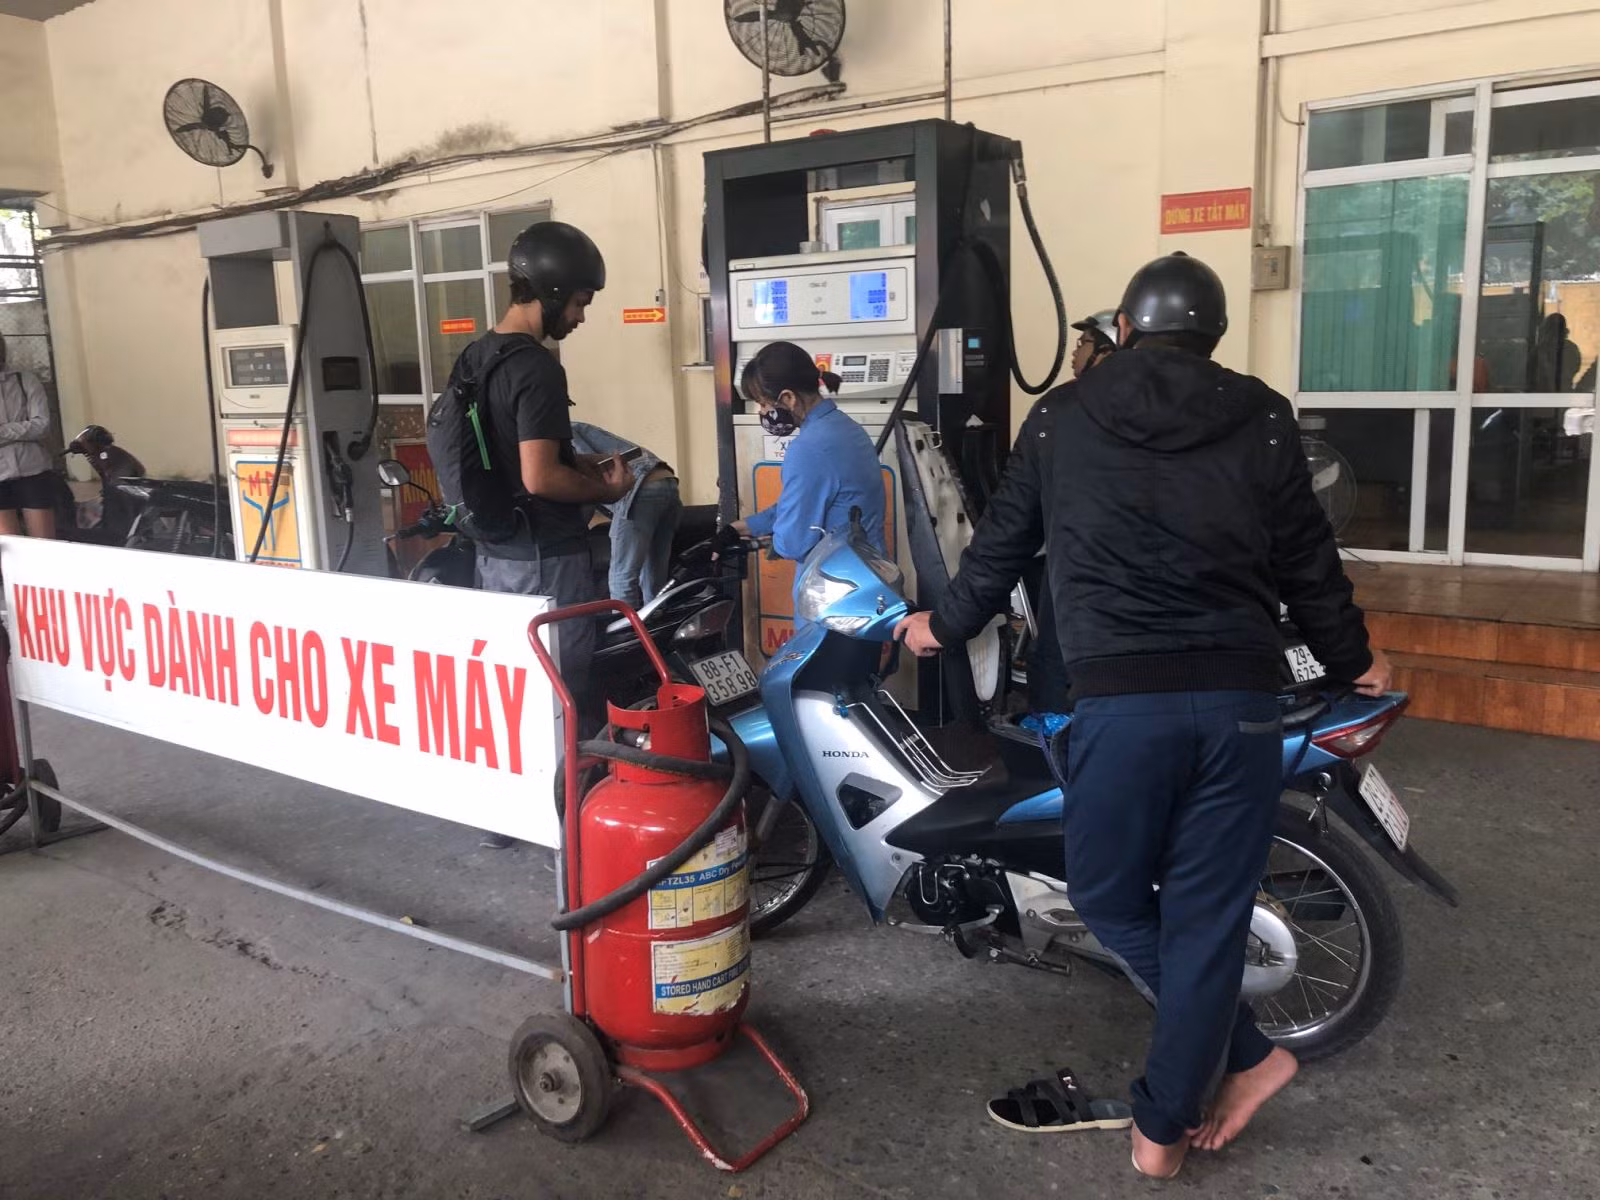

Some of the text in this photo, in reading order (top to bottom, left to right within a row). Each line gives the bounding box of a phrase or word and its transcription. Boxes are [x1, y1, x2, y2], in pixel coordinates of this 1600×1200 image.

[1193, 206, 1205, 224] XE
[700, 653, 742, 680] 88-F1
[14, 584, 527, 775] KHU VỰC DÀNH CHO XE MÁY
[707, 670, 757, 701] 358.98
[822, 750, 870, 758] HONDA
[699, 870, 718, 881] ABC
[661, 984, 691, 997] STORED
[692, 979, 712, 992] HAND
[712, 972, 728, 986] CART
